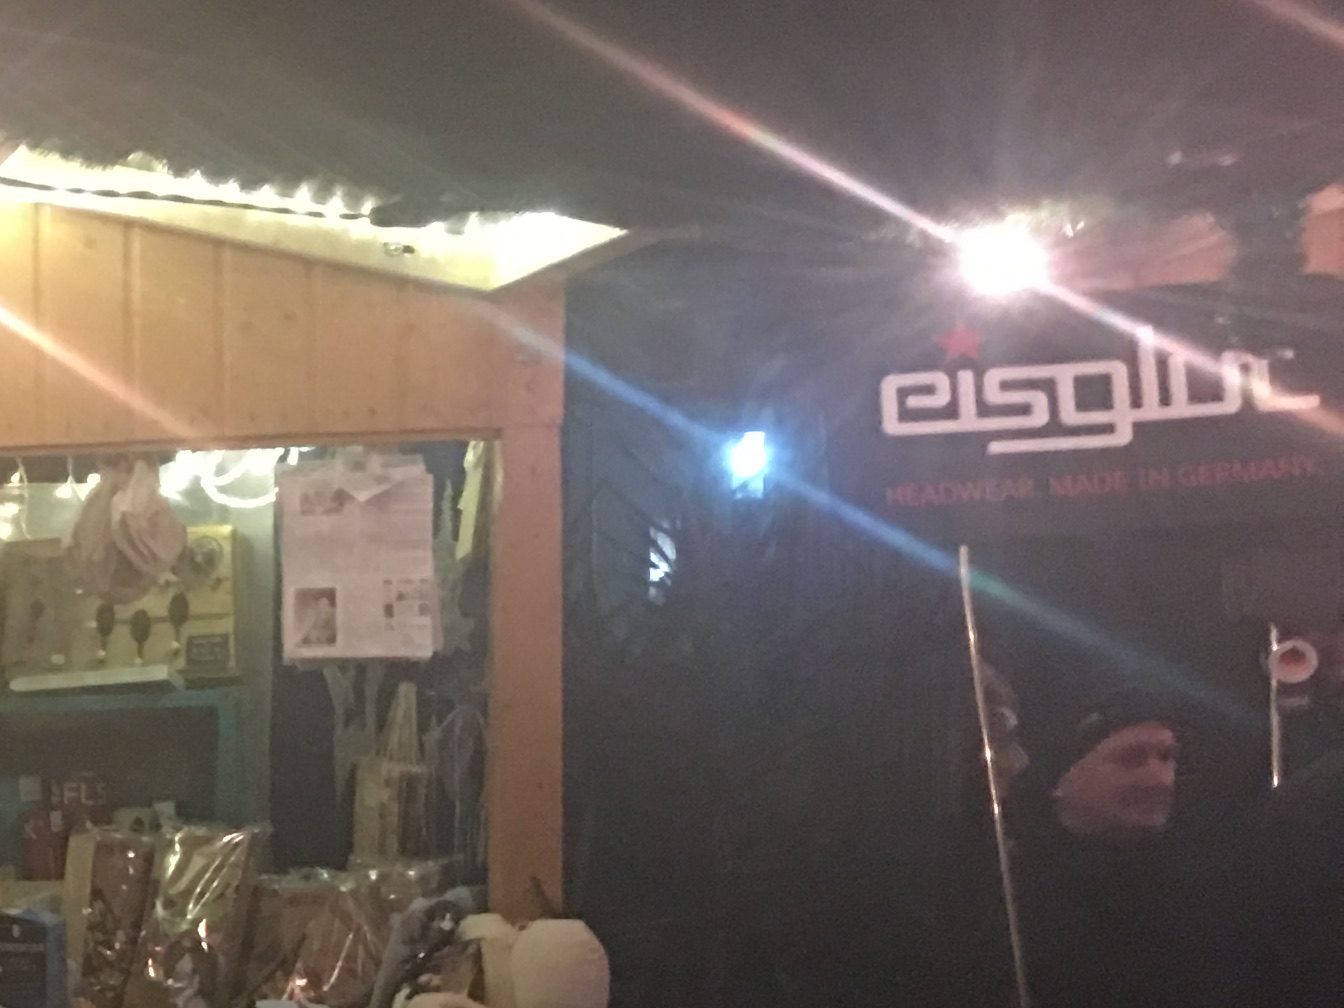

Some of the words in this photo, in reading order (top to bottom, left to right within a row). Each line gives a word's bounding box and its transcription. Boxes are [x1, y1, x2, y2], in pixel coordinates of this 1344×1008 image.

[1049, 469, 1126, 497] MADE
[1138, 466, 1169, 490] IN
[1177, 452, 1313, 488] GERMANY
